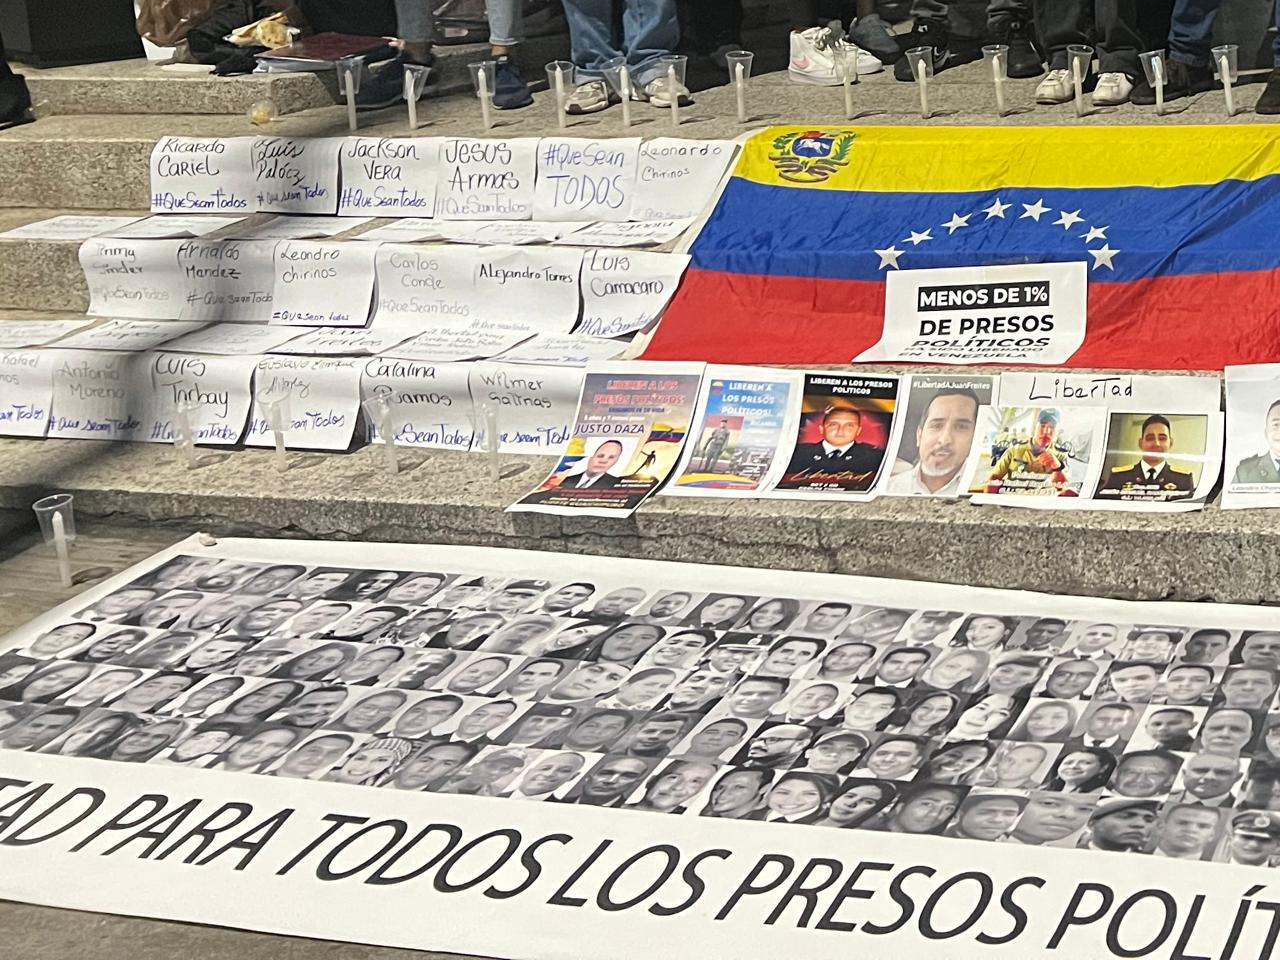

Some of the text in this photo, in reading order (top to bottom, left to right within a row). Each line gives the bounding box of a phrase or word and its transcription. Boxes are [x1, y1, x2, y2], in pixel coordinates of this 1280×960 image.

[546, 174, 625, 211] TODOS
[390, 251, 439, 272] Carlos
[919, 285, 1048, 308] MENOS DE 1%
[918, 314, 1054, 337] DE PRESOS
[911, 335, 1051, 348] POLÍTICOS
[810, 377, 842, 386] LIBEREN
[849, 379, 863, 387] LOS
[864, 380, 893, 389] PRESOS
[575, 423, 645, 435] JUSTO DAZA
[68, 793, 295, 872] PARA
[277, 813, 573, 901] TODOS
[547, 837, 733, 917] LOS
[714, 850, 1047, 945] PRESOS
